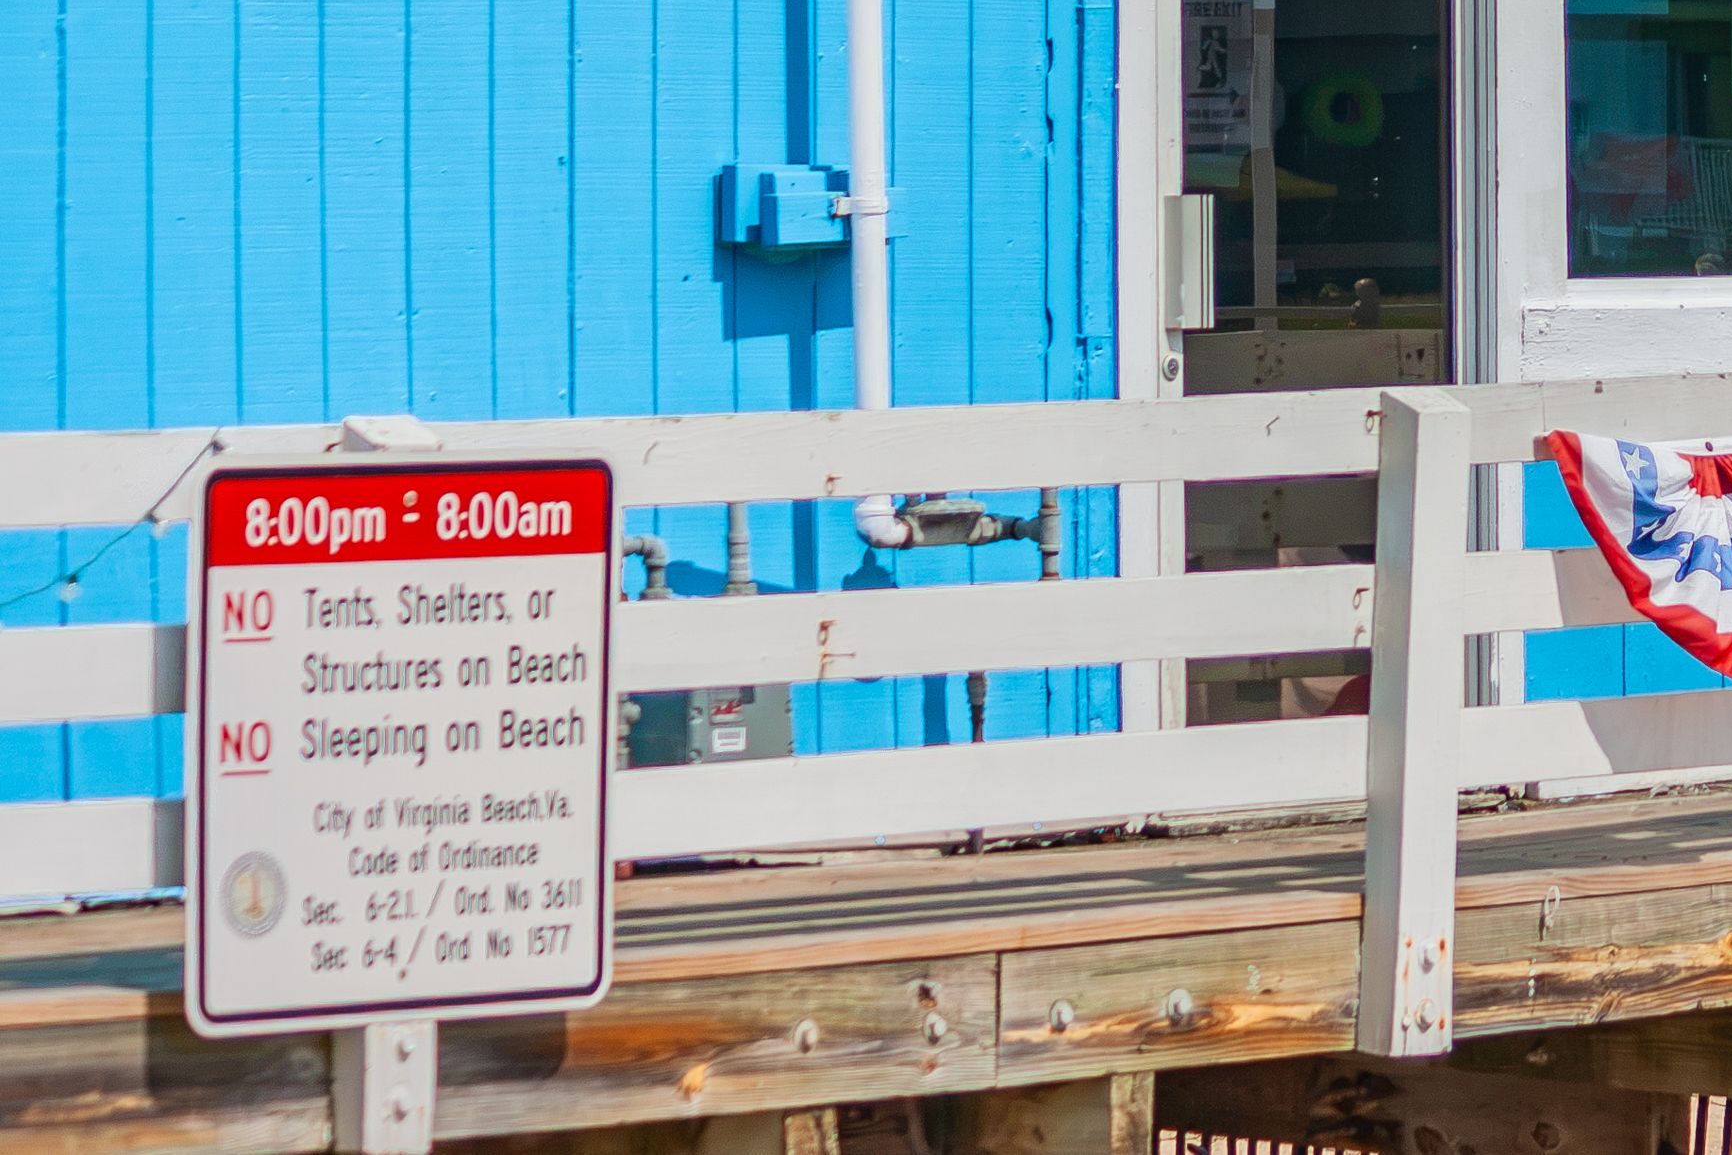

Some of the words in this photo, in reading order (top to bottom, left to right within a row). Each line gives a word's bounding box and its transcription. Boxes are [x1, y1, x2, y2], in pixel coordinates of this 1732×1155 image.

[245, 496, 386, 554] 8:00pm
[436, 490, 573, 541] 8:00am
[223, 589, 274, 632] NO
[303, 587, 382, 630] Tents,
[396, 583, 512, 625] Shelters,
[527, 589, 555, 620] or
[301, 650, 443, 694] Structures
[457, 655, 490, 687] on
[506, 642, 588, 685] Beach
[220, 720, 272, 763] NO
[301, 713, 428, 768] Sleeping
[445, 720, 480, 753] on
[498, 706, 585, 749] Beach
[313, 799, 354, 840] City
[364, 798, 386, 830] of
[393, 794, 471, 836] Virginia
[349, 845, 398, 876] Code
[408, 842, 430, 872] of
[438, 839, 540, 871] Ordinance
[541, 877, 585, 910] 3611
[527, 922, 574, 956] 1577
